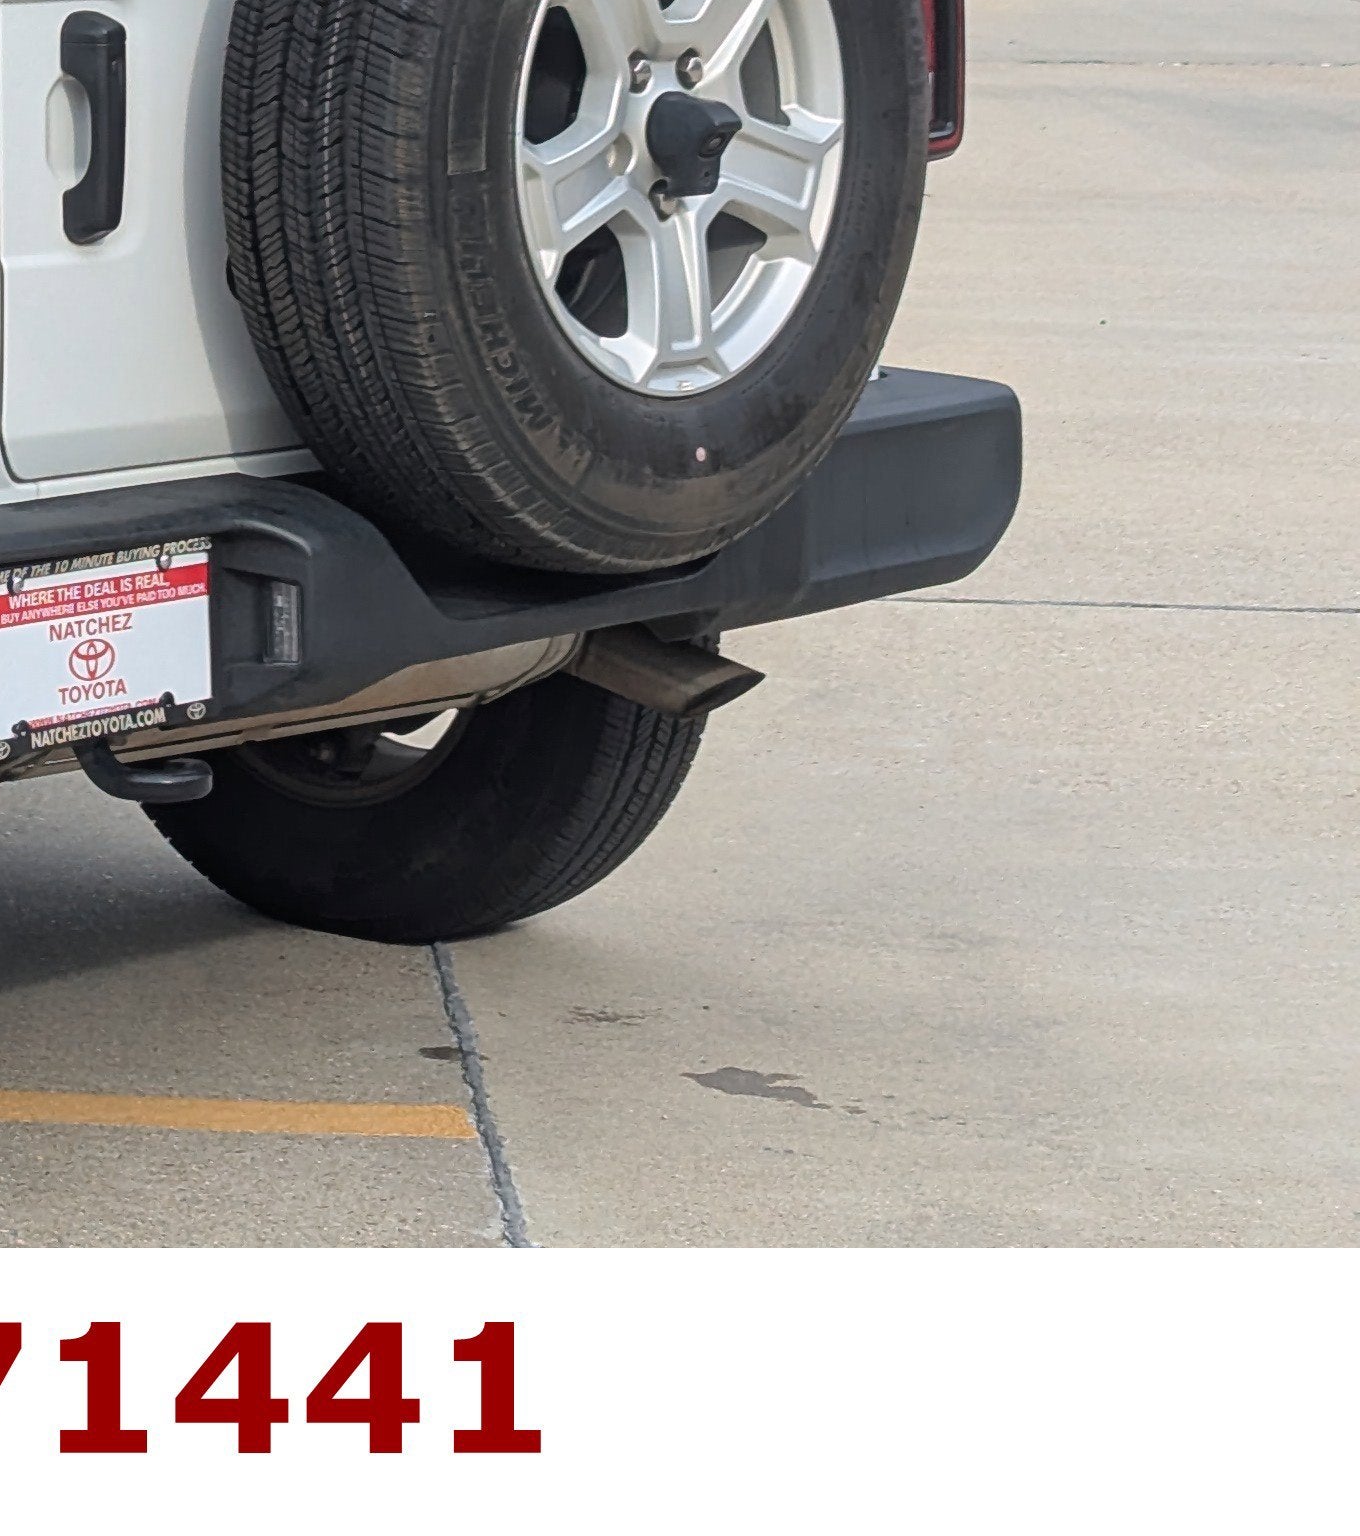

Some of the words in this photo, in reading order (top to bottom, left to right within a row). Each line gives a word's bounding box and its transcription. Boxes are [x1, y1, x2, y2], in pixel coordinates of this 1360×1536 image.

[12, 567, 29, 581] OF
[30, 563, 52, 577] THE
[54, 559, 70, 574] 10
[70, 552, 116, 571] MINUTE
[116, 544, 161, 564] BUYING
[162, 536, 213, 556] PROCESS
[1, 611, 21, 625] BUY
[22, 602, 75, 620] ANYWHERE
[77, 599, 99, 613] ELSE
[136, 590, 158, 603] PAID
[158, 587, 176, 600] TOO
[9, 590, 56, 610] WHERE
[57, 584, 82, 602] THE
[84, 576, 118, 599] DEAL
[120, 577, 133, 592] IS
[49, 612, 133, 642] NATCHEZ
[58, 678, 127, 705] TOYOTA
[30, 706, 167, 750] NATCHEZTOYOTA.COM
